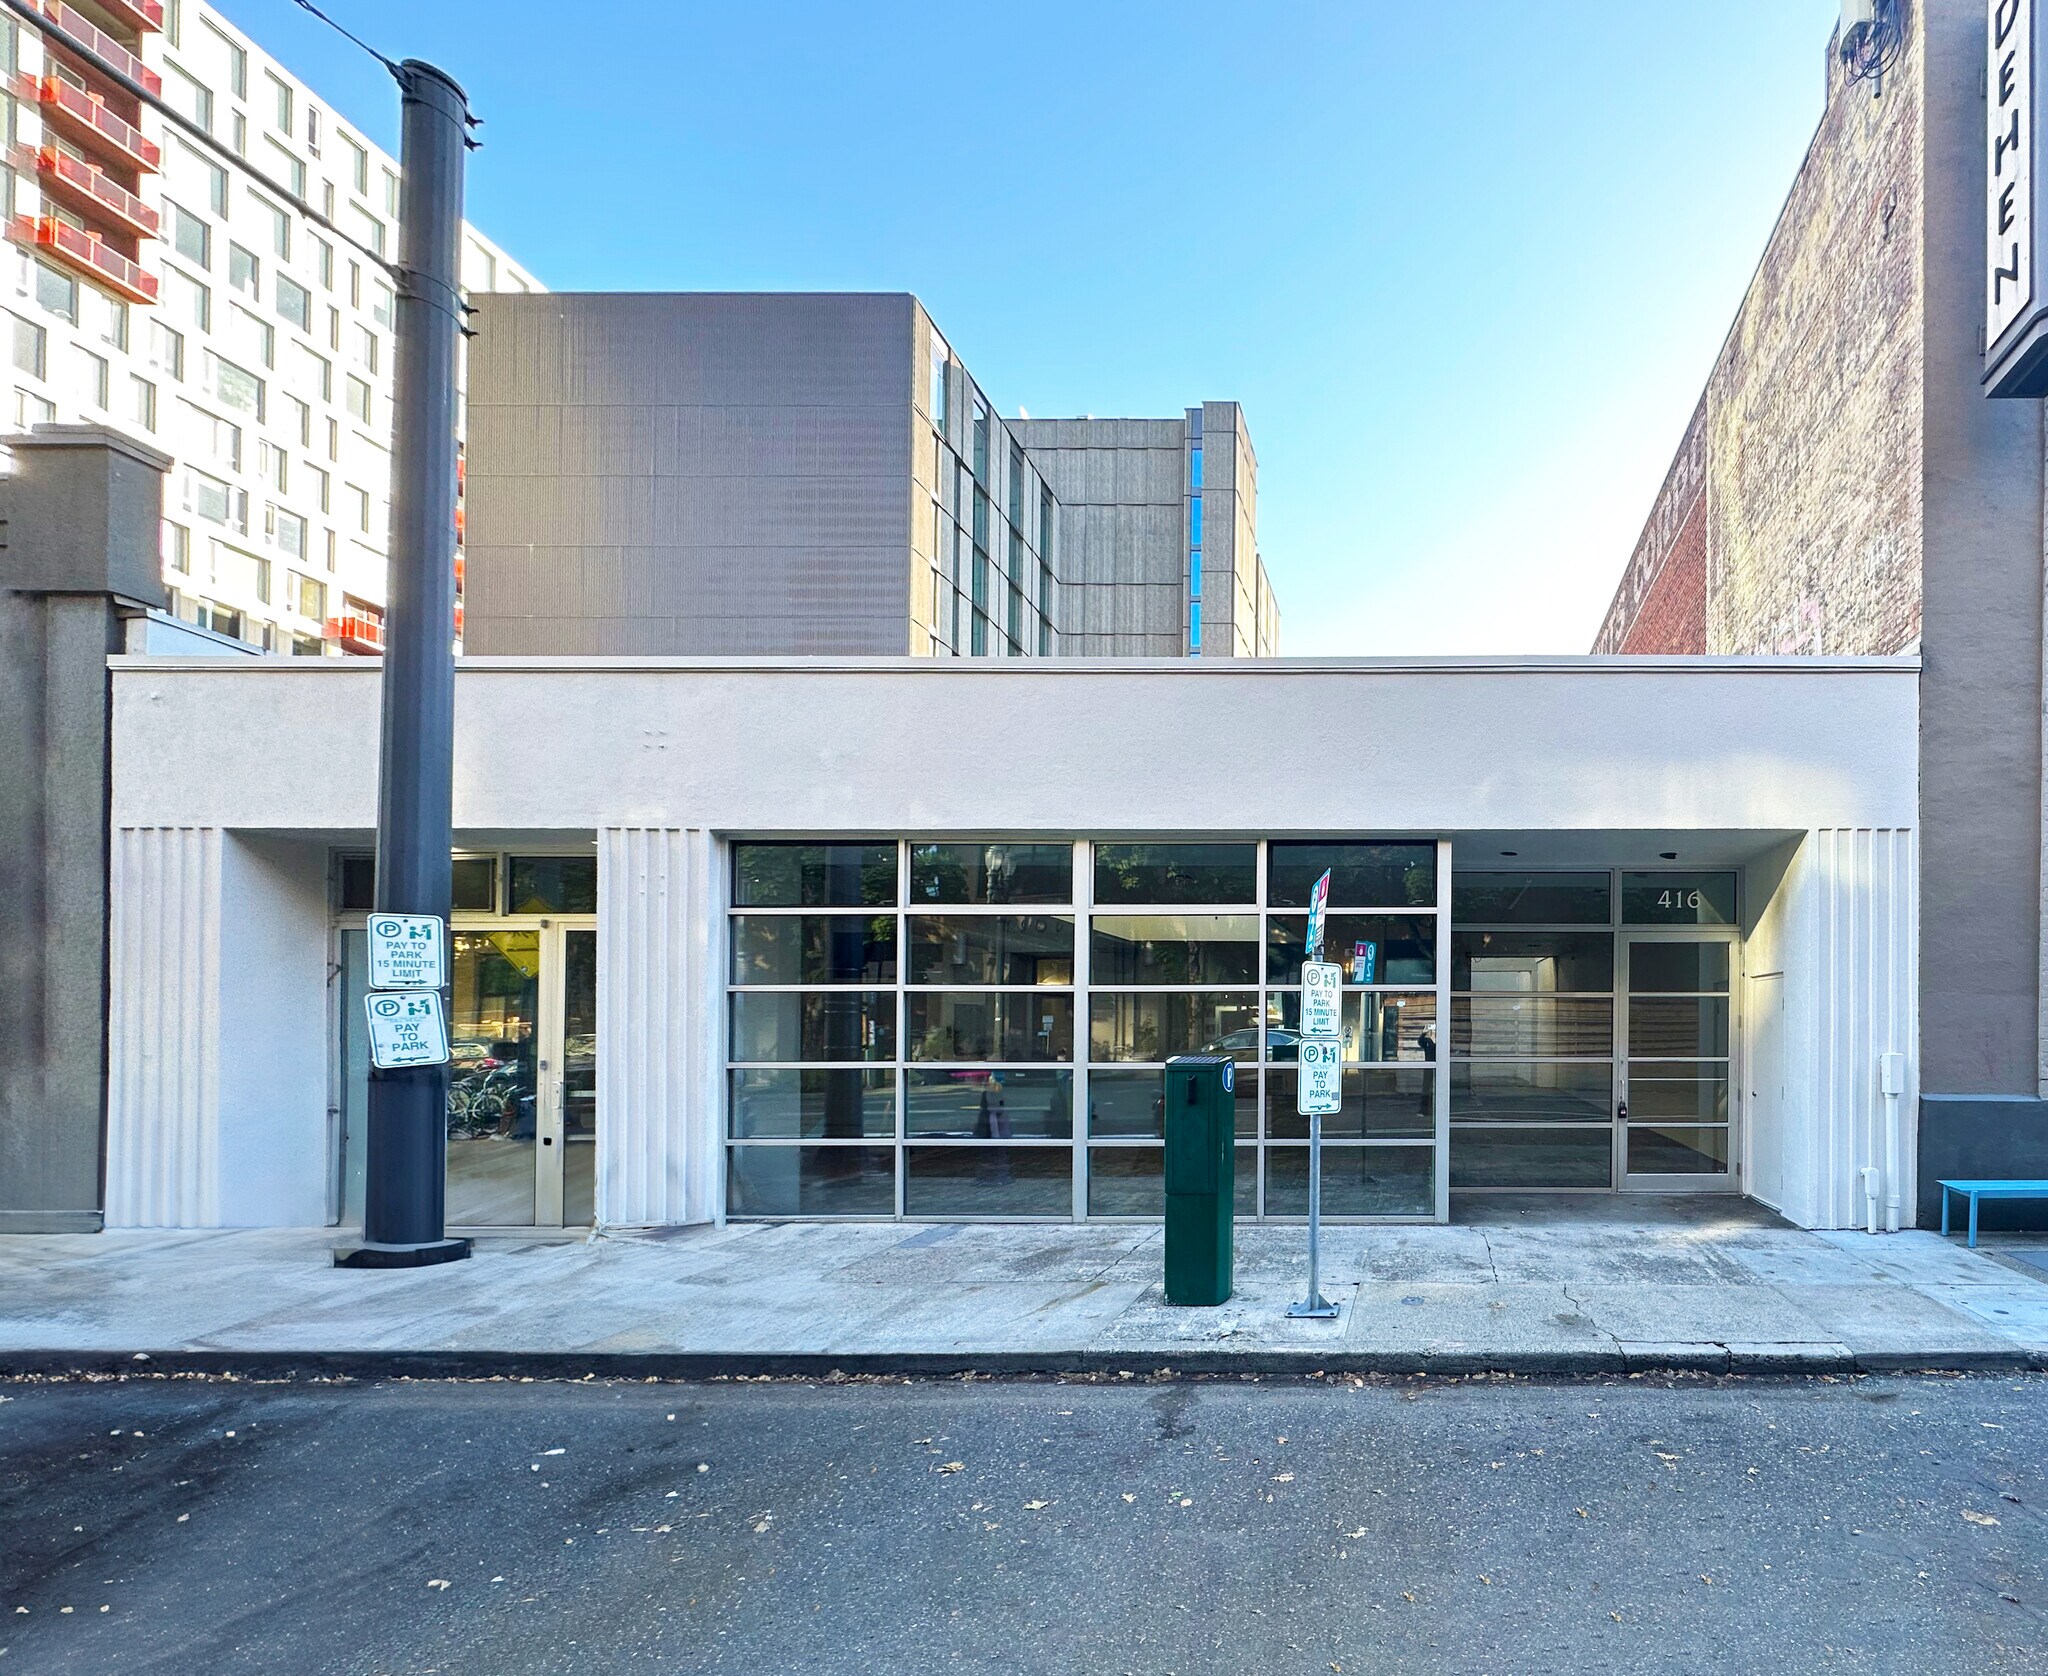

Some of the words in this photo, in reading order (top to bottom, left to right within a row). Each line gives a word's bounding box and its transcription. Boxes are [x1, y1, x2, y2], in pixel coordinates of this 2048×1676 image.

[1994, 0, 2019, 306] DEHEN
[1657, 888, 1701, 909] 416
[384, 924, 397, 935] P
[386, 941, 408, 950] PAY
[411, 941, 427, 950] TO
[390, 951, 422, 959] PARK
[377, 960, 390, 968] 15
[393, 960, 436, 969] MINUTE
[392, 969, 423, 978] LIMIT
[1310, 989, 1323, 998] PAY
[1324, 990, 1333, 999] TO
[1312, 999, 1331, 1007] PARK
[382, 1003, 395, 1014] P
[1305, 1007, 1313, 1016] 15
[1313, 1007, 1338, 1017] MINUTE
[1312, 1017, 1330, 1026] LIMIT
[394, 1023, 420, 1033] PAY
[399, 1032, 418, 1042] TO
[391, 1041, 429, 1052] PARK
[1308, 1049, 1316, 1060] P
[1312, 1071, 1328, 1080] PAY
[1314, 1080, 1327, 1089] TO
[1309, 1089, 1331, 1099] PARK
